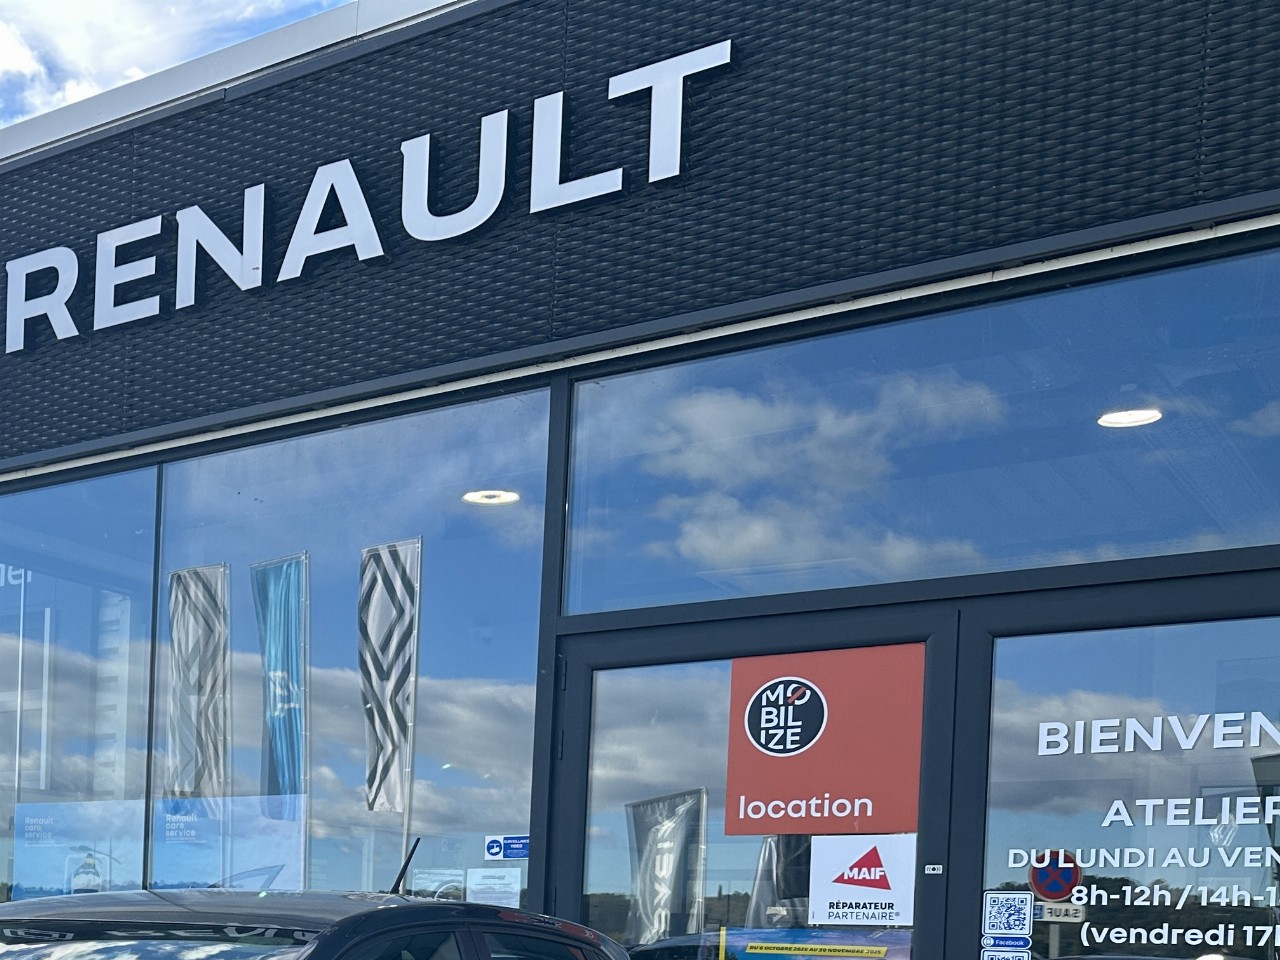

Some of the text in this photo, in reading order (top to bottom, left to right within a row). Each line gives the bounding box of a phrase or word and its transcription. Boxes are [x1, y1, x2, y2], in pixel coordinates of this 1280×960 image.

[5, 40, 731, 353] RENAULT
[1038, 712, 1280, 756] BIENVEN
[166, 813, 198, 822] Renault
[739, 793, 872, 819] location
[1008, 846, 1280, 868] DU LUNDI AU VEN
[844, 867, 884, 879] MAIF
[829, 900, 894, 910] RÉPARATEUR
[1070, 884, 1280, 910] 8h-12h / 14h-1
[1080, 922, 1234, 947] (vendredi
